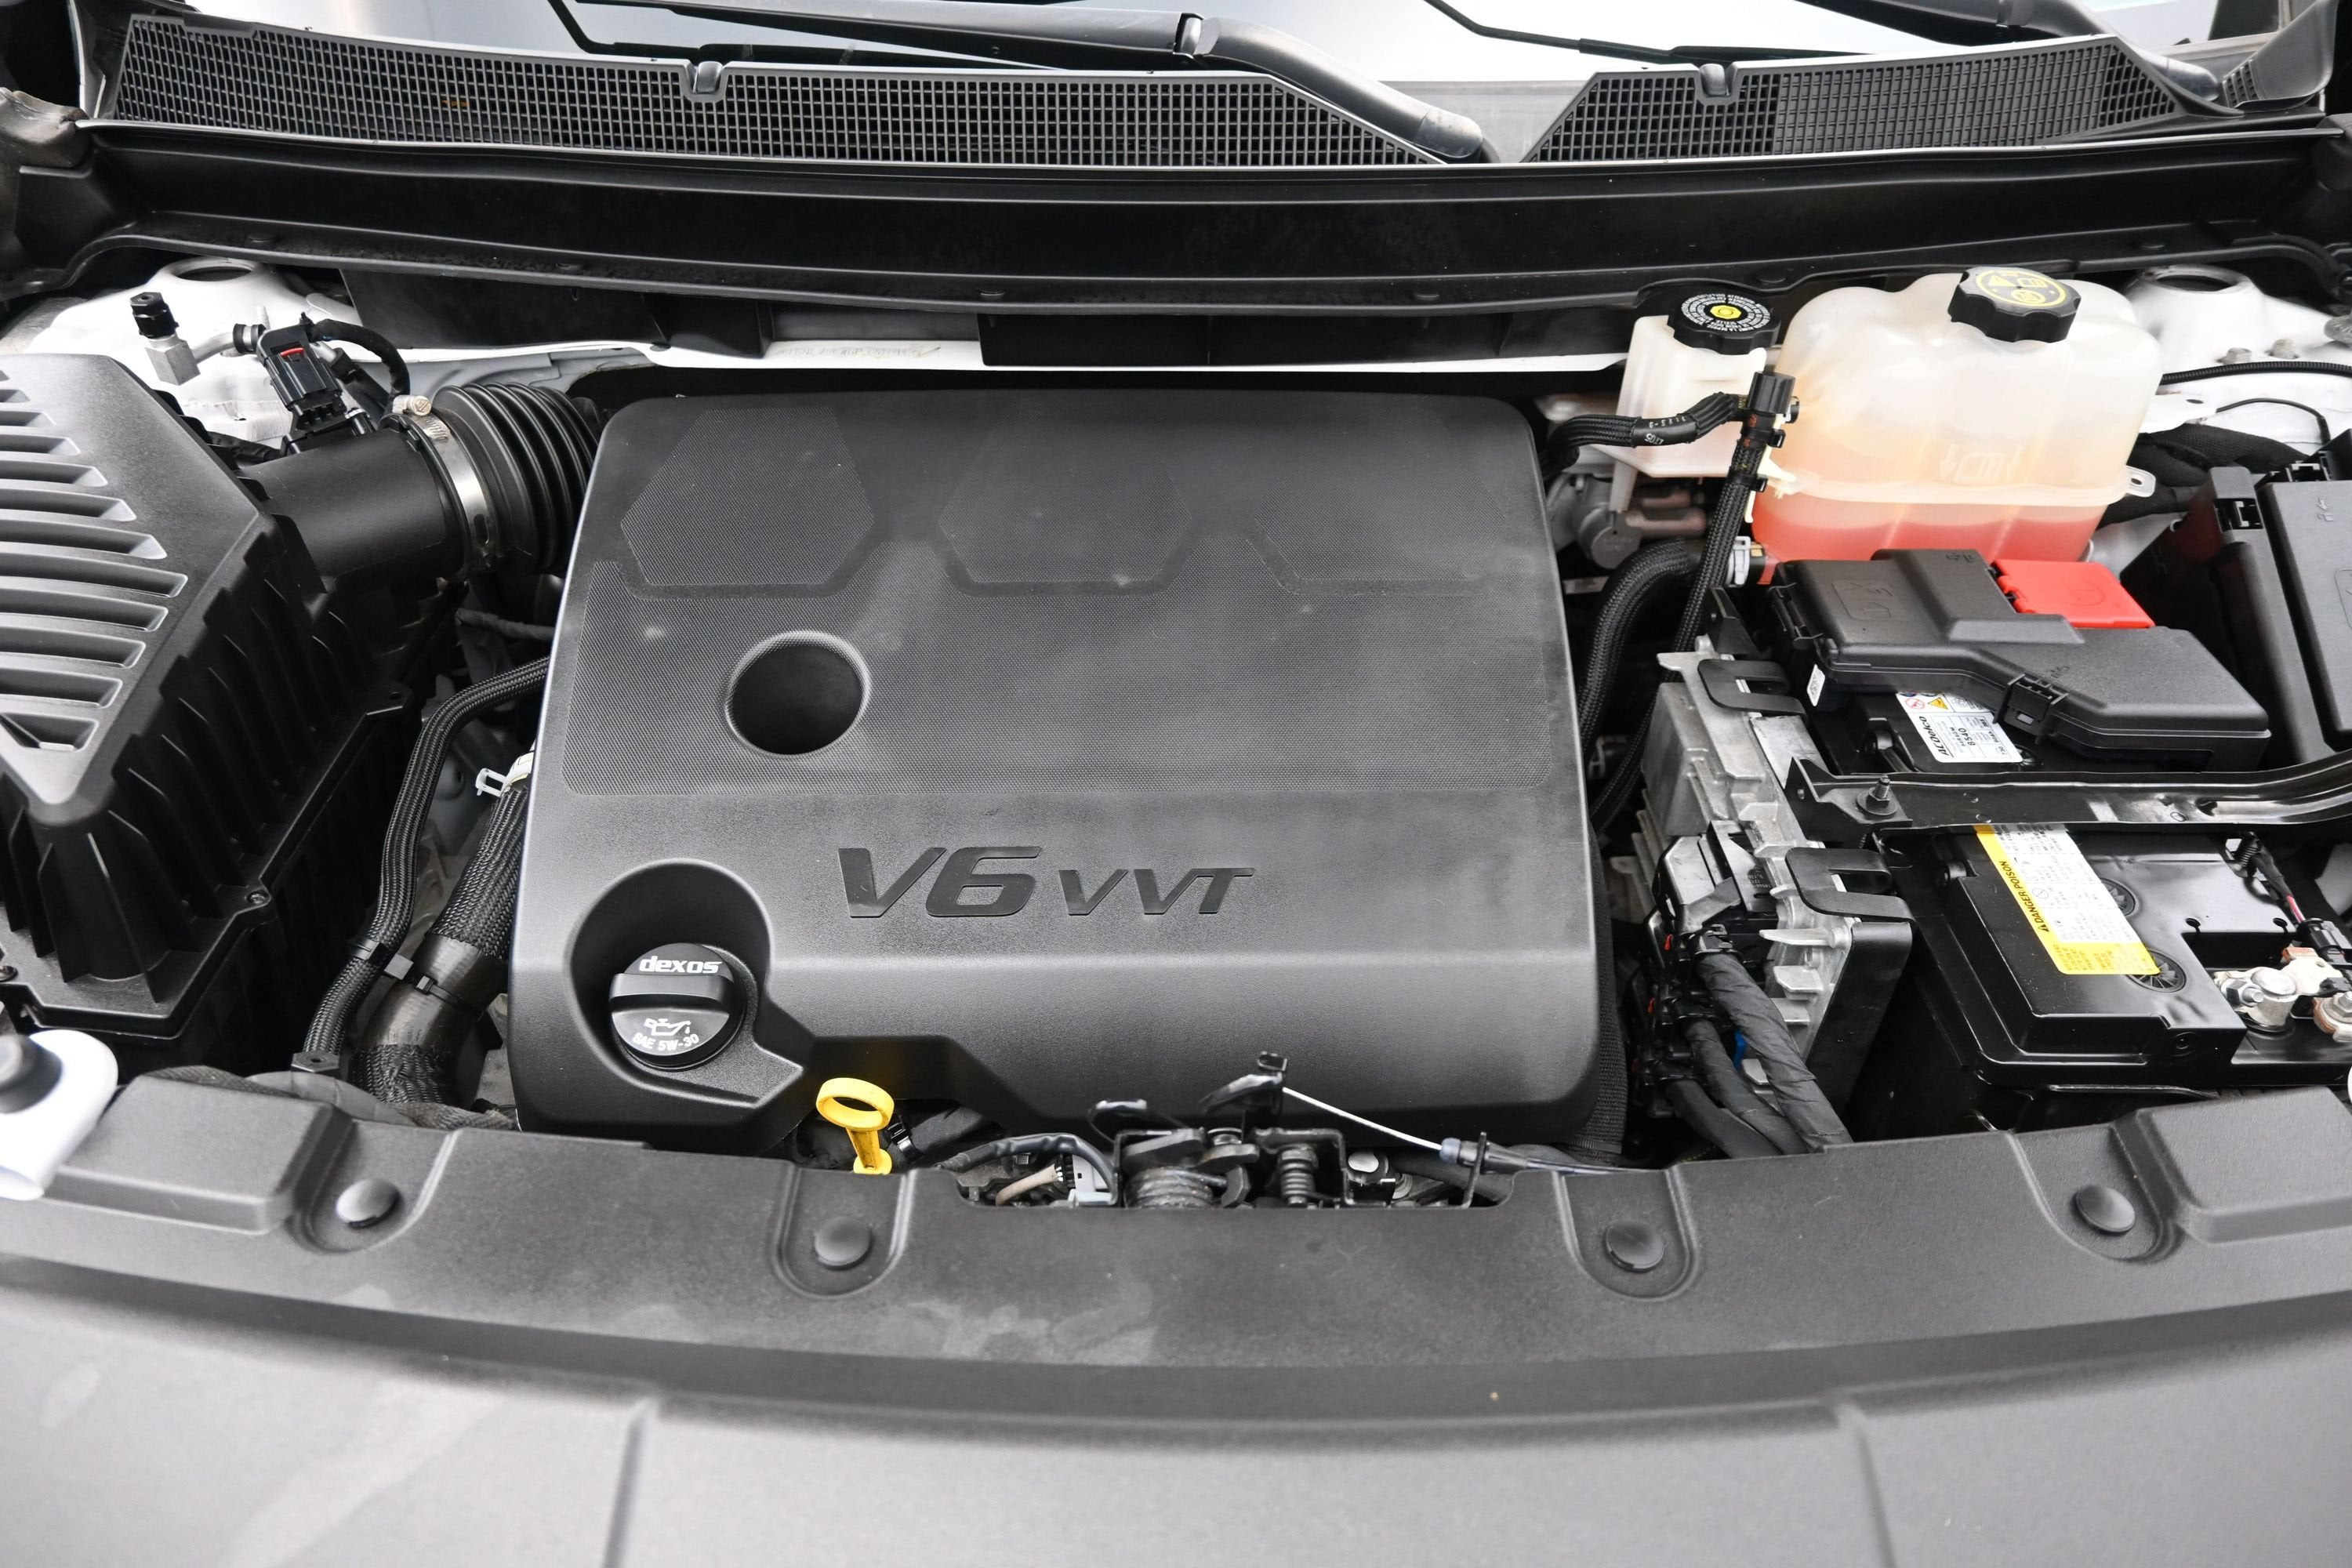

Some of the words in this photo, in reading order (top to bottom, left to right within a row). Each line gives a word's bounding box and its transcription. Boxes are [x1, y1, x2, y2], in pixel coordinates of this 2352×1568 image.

[1918, 716, 1950, 757] ACDelco
[1958, 728, 1976, 746] 8540
[838, 846, 1043, 918] V6
[1058, 867, 1255, 916] VVT
[1998, 861, 2024, 890] POISON
[2018, 891, 2045, 924] DANGER
[639, 956, 723, 974] dexos
[632, 1033, 656, 1050] SAE
[658, 1033, 699, 1051] 5W-30
